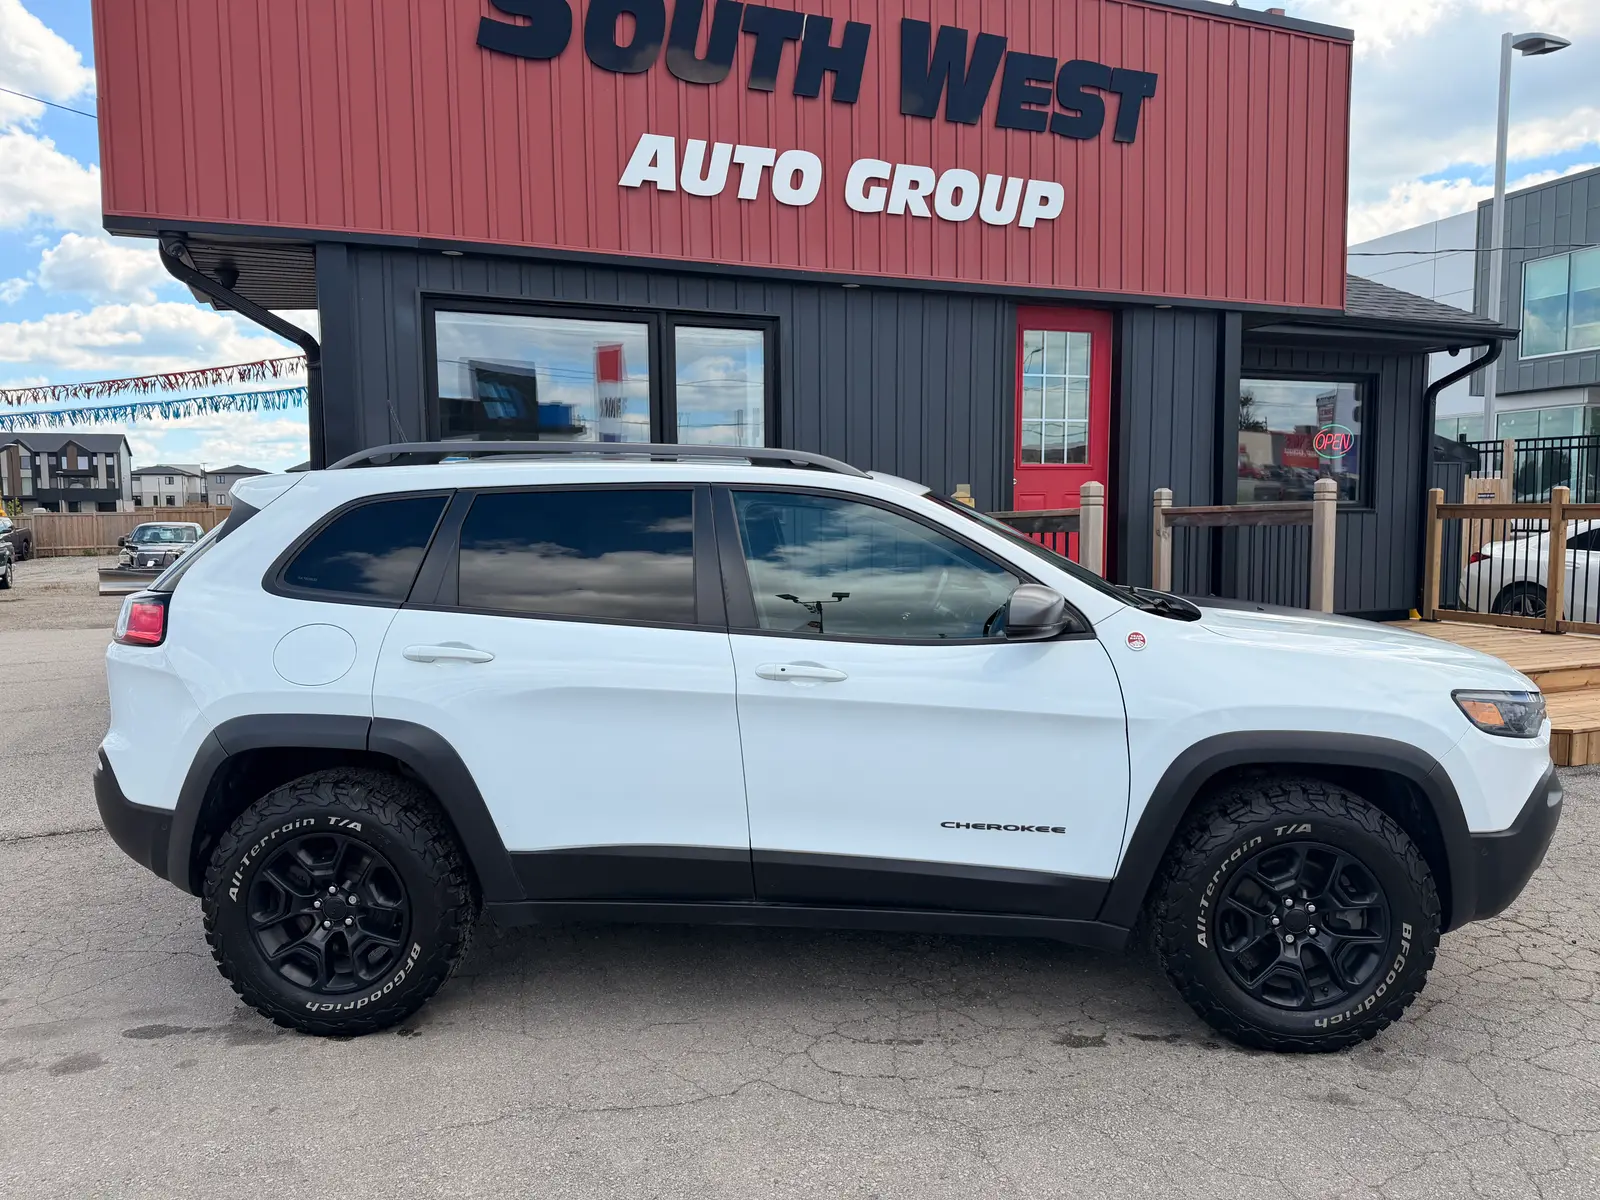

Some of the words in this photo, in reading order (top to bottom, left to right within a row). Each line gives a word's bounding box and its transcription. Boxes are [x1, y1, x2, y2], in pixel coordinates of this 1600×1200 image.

[900, 17, 1158, 143] WEST
[618, 133, 823, 206] AUTO
[844, 158, 1065, 228] GROUP
[1315, 433, 1350, 450] OPEN
[229, 818, 315, 902] All-Terrain
[327, 816, 363, 832] T/A
[940, 821, 1067, 834] CHEROKEE
[1196, 835, 1262, 948] All-Terrain
[1274, 823, 1312, 836] T/A
[305, 942, 421, 1013] BFGoodrich
[1314, 922, 1412, 1028] BFGoodrich
